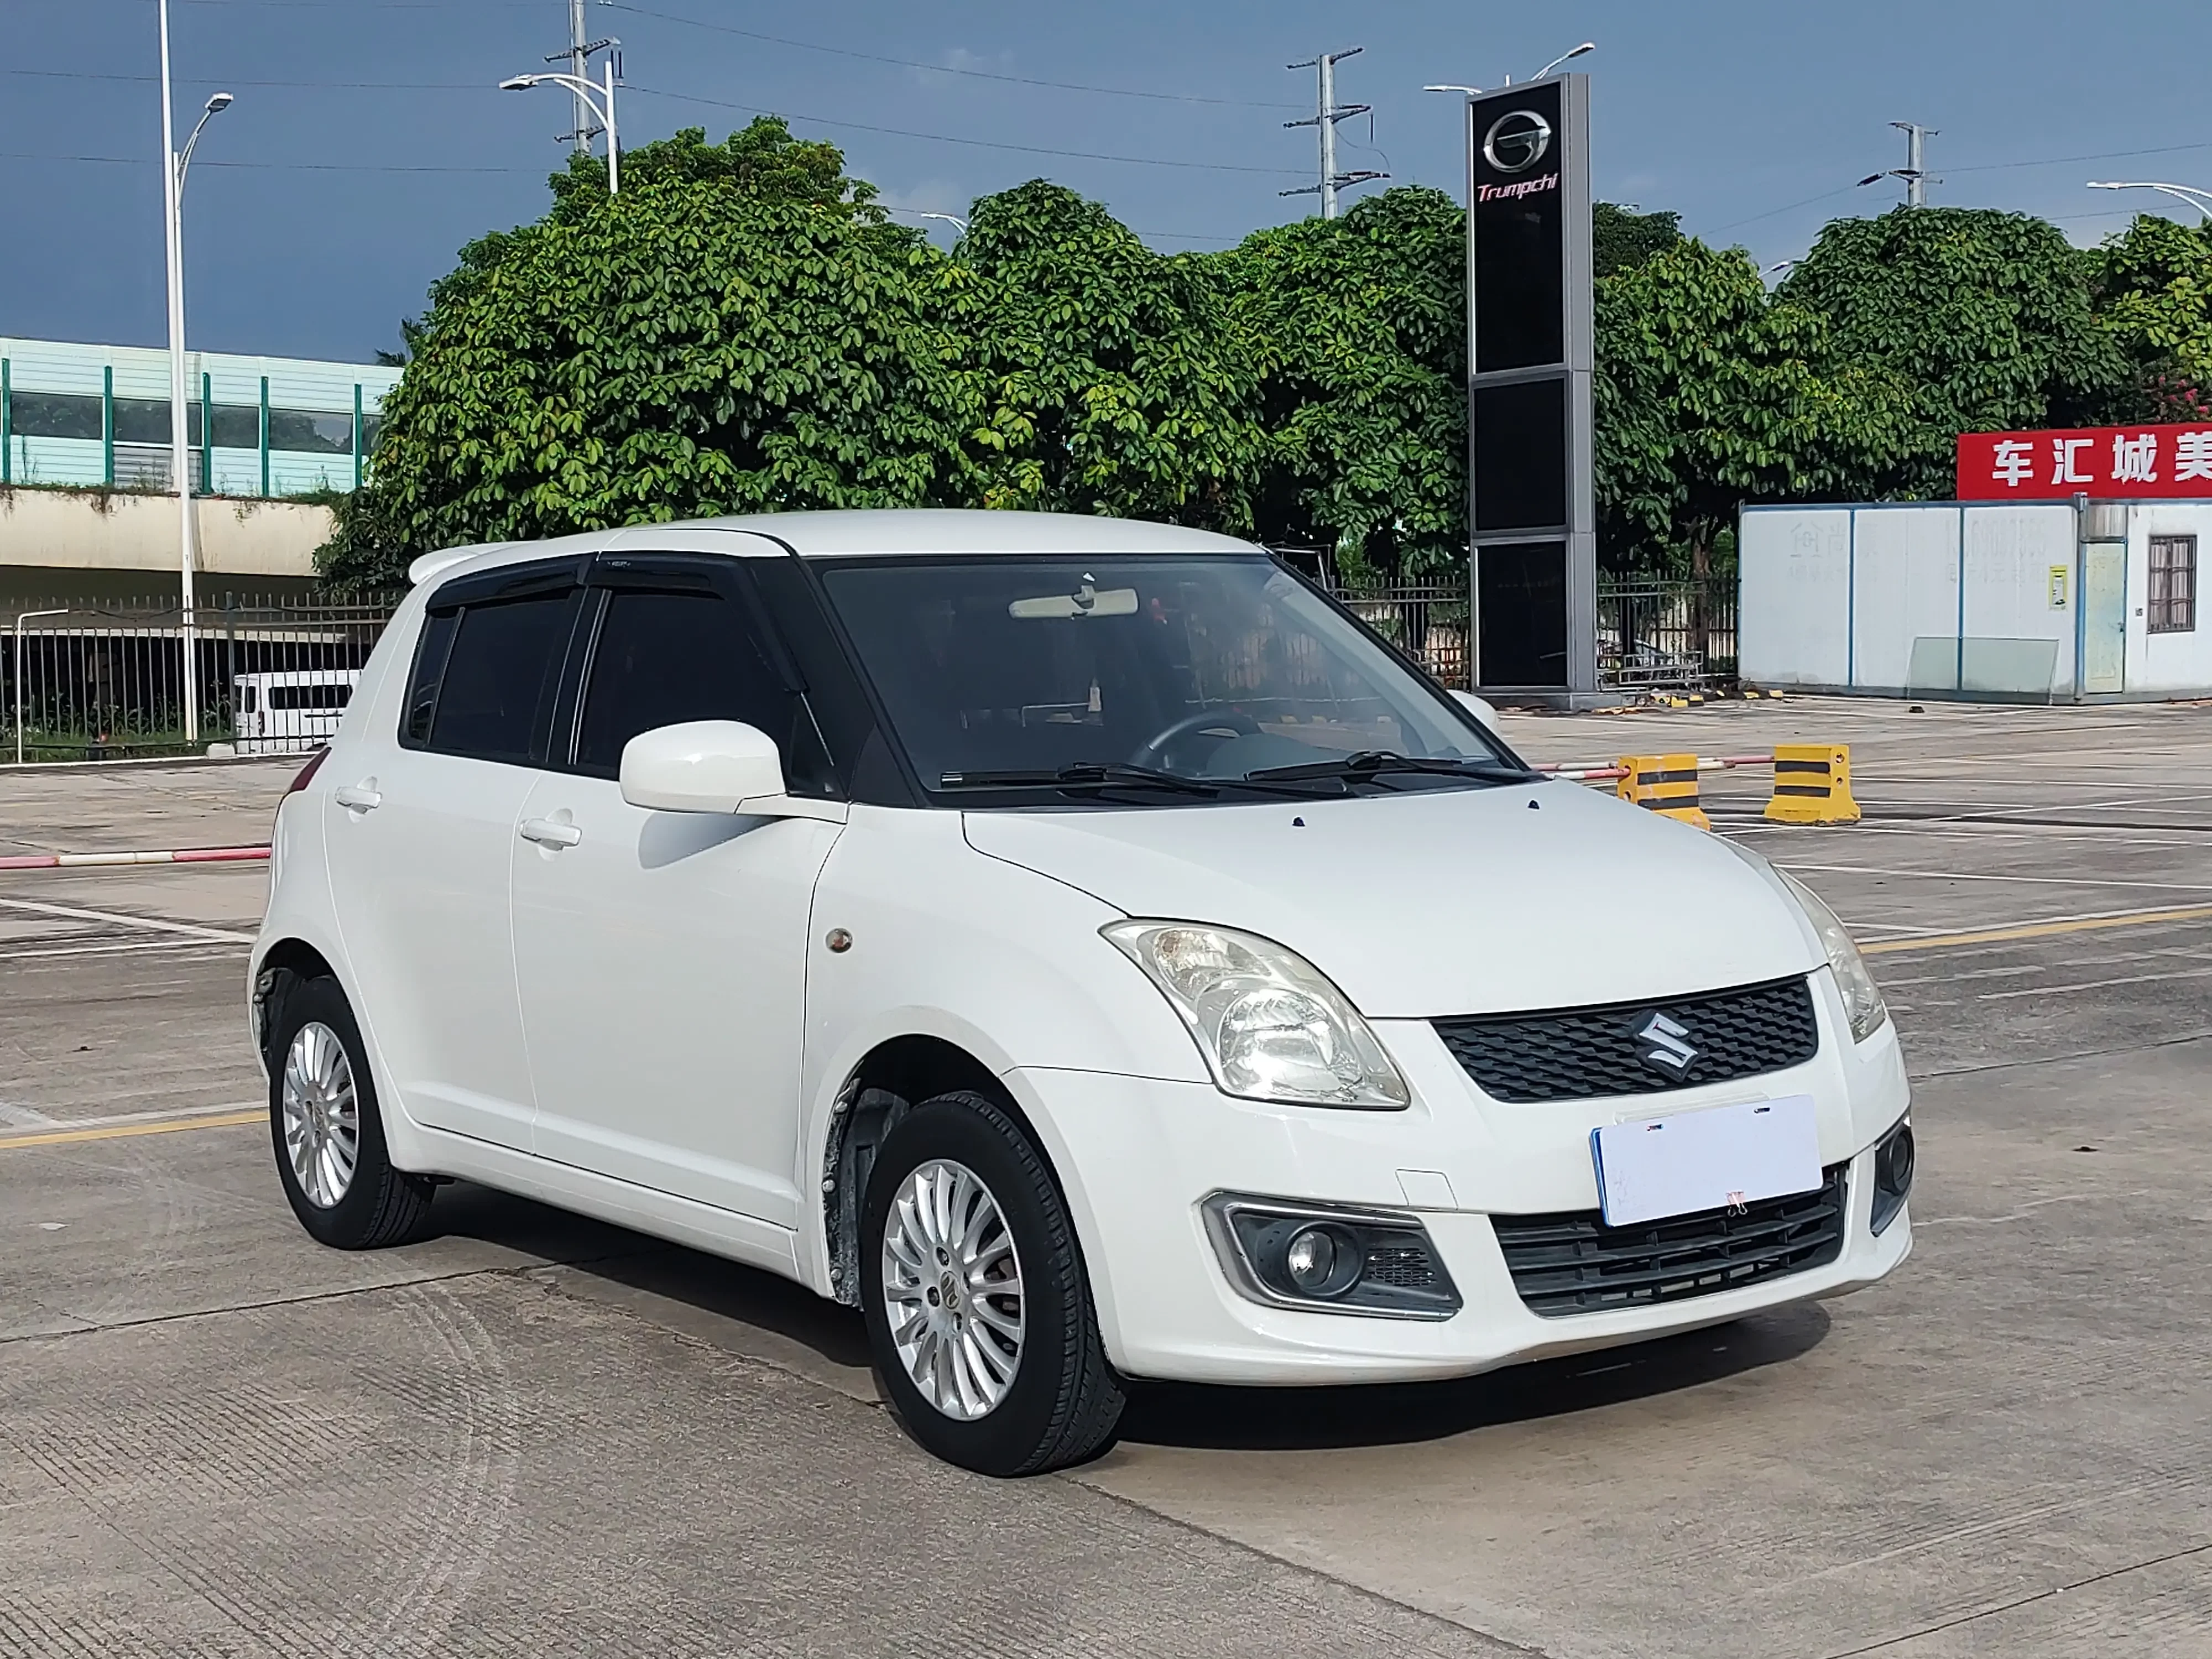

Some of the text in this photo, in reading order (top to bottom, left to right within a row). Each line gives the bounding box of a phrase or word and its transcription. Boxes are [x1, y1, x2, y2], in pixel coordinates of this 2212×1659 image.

[1478, 173, 1558, 202] Trumpchi
[1992, 431, 2212, 487] 车汇城美
